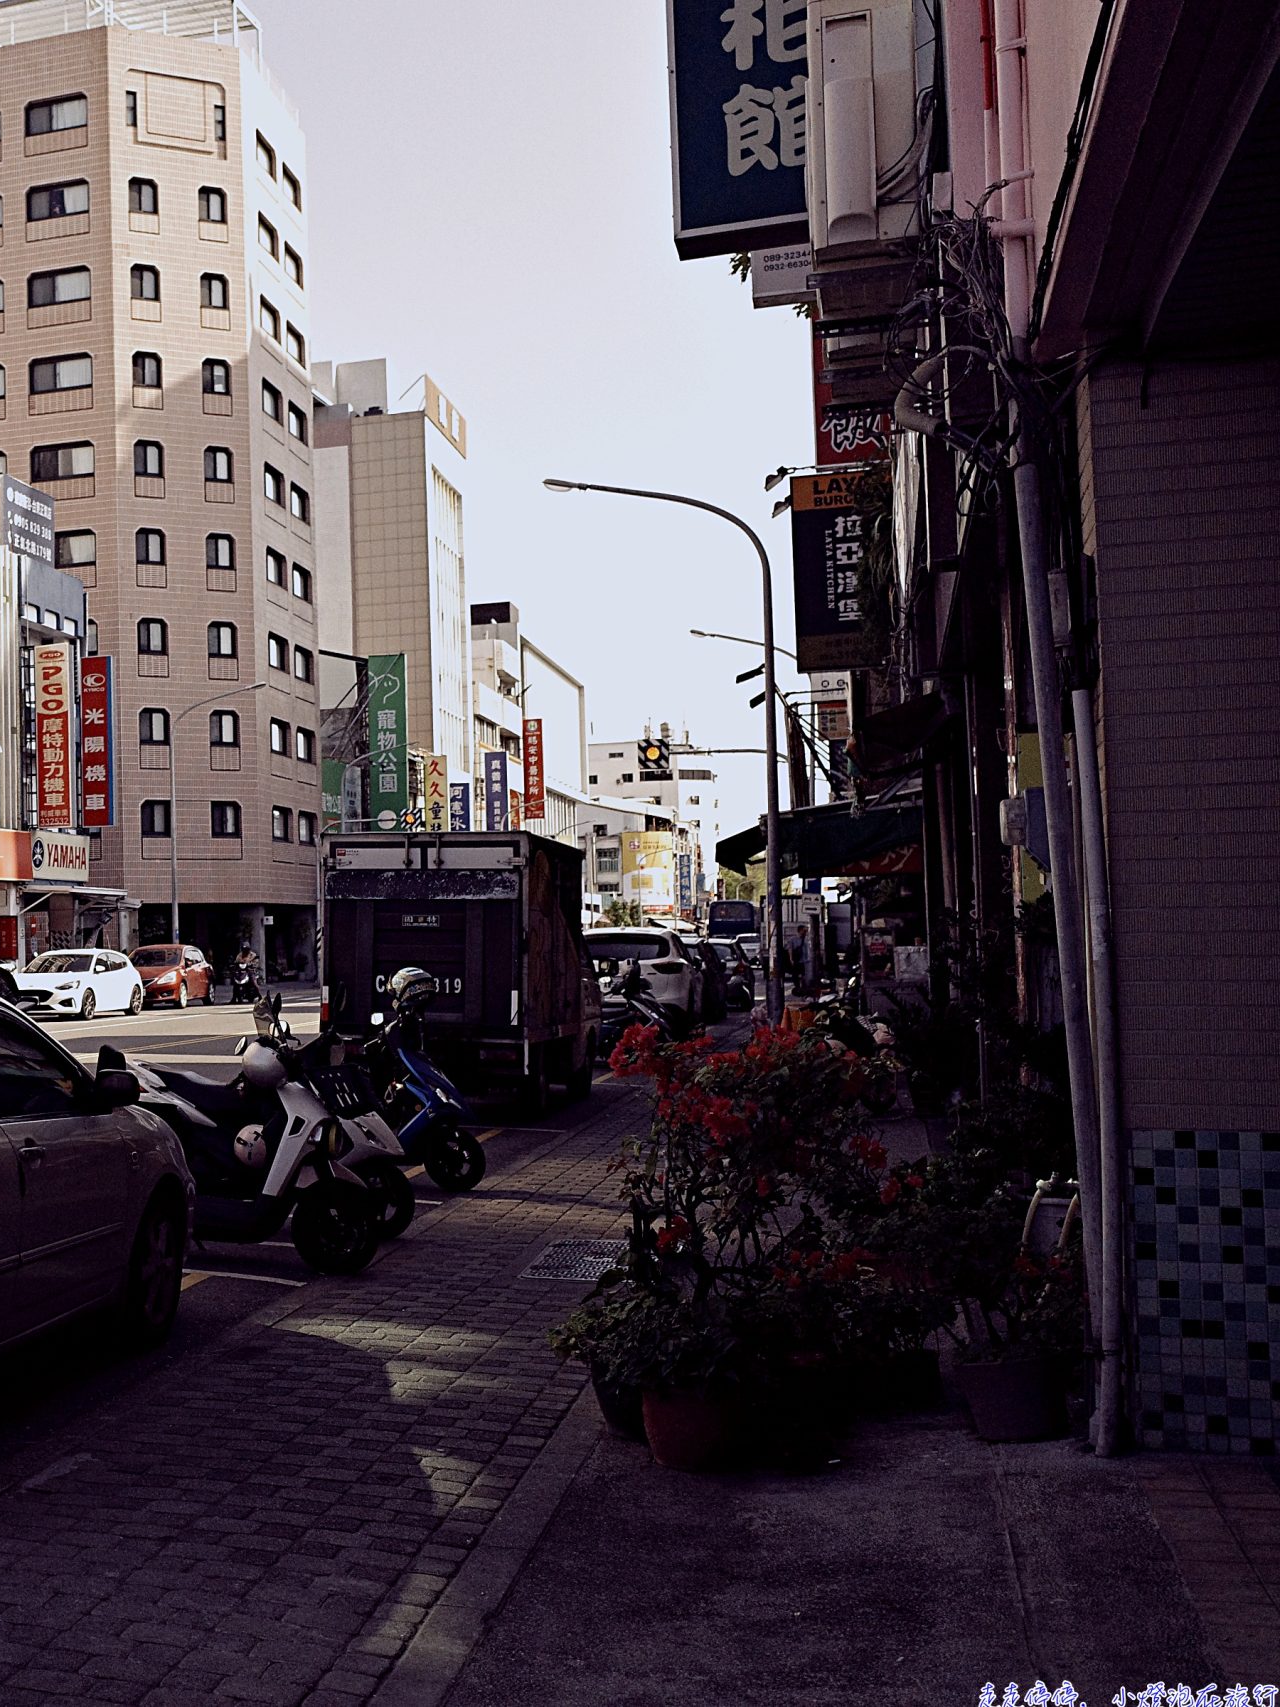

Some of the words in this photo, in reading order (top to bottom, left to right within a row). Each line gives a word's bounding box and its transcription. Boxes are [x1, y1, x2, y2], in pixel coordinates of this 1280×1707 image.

[813, 476, 865, 495] LAY
[825, 529, 833, 556] LAYA
[826, 560, 835, 609] KITCHEN
[41, 666, 64, 712] PGO
[42, 718, 65, 807] 摩特動力機車
[84, 708, 106, 810] 光陽機車
[377, 709, 398, 793] 寵物公園
[40, 817, 69, 826] 332532
[47, 843, 87, 870] YAMAHA
